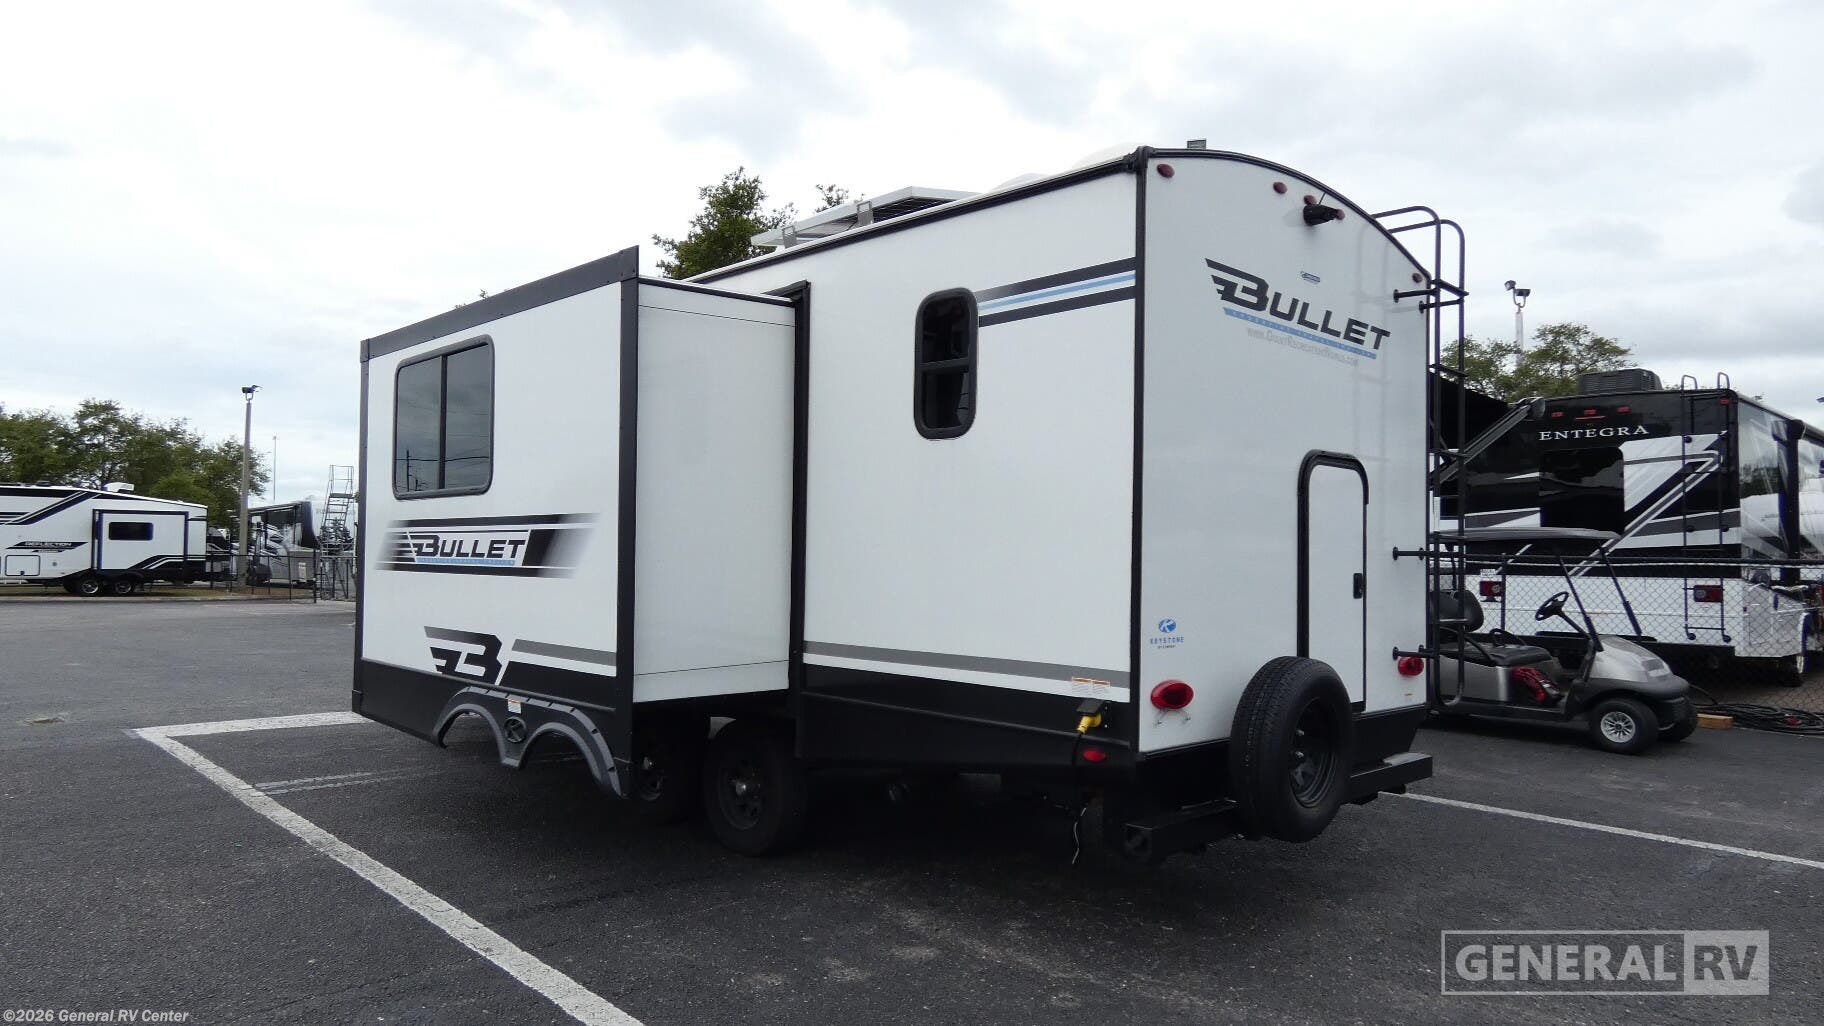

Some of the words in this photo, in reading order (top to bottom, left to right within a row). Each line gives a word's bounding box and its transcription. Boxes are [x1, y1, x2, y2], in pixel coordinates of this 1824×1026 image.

[1205, 257, 1391, 350] BULLET
[1538, 425, 1650, 441] ENTEGRA
[405, 534, 526, 559] BULLET
[1150, 636, 1185, 645] KEYSTONE
